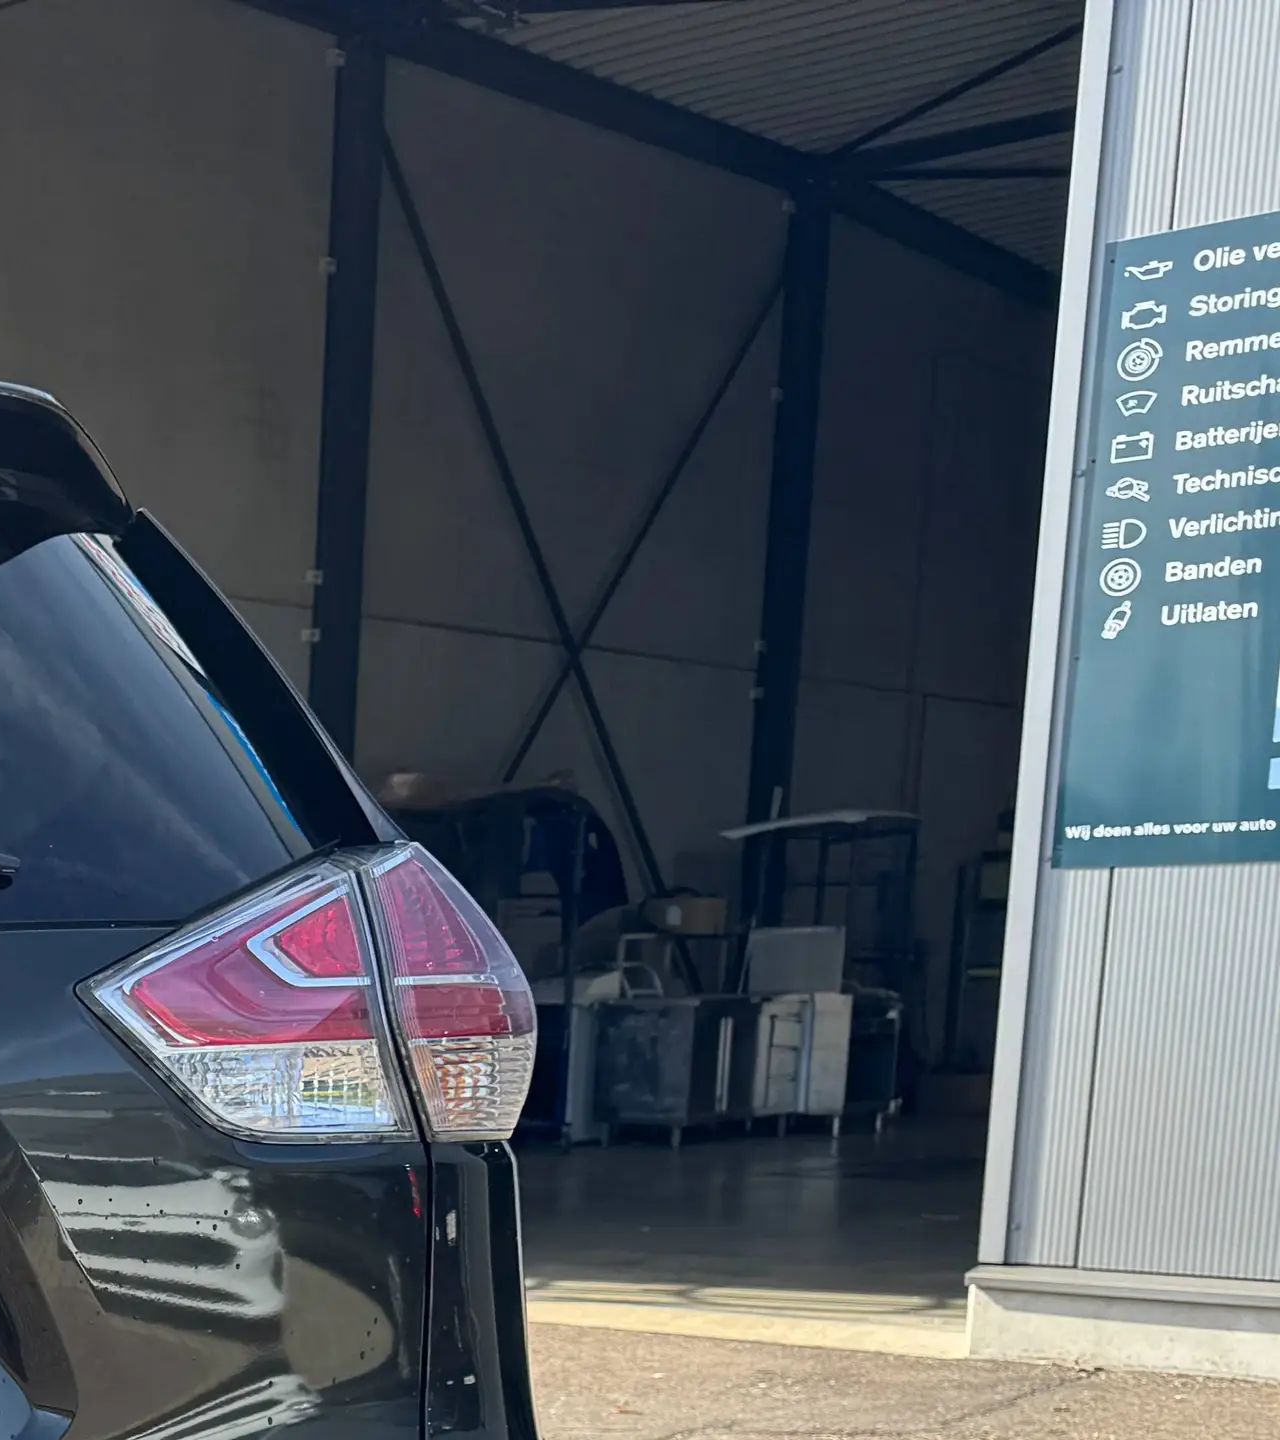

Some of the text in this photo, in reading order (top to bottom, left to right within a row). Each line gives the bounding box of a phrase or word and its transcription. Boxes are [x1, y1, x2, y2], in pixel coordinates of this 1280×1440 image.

[1193, 242, 1280, 272] Olie ve
[1188, 287, 1280, 317] Storing
[1184, 332, 1280, 362] Remme
[1175, 421, 1280, 451] Batterije
[1173, 465, 1280, 495] Technisc
[1165, 556, 1262, 582] Banden
[1161, 600, 1258, 626] Uitlaten
[1064, 818, 1277, 841] Wij doen alles voor uw auto
